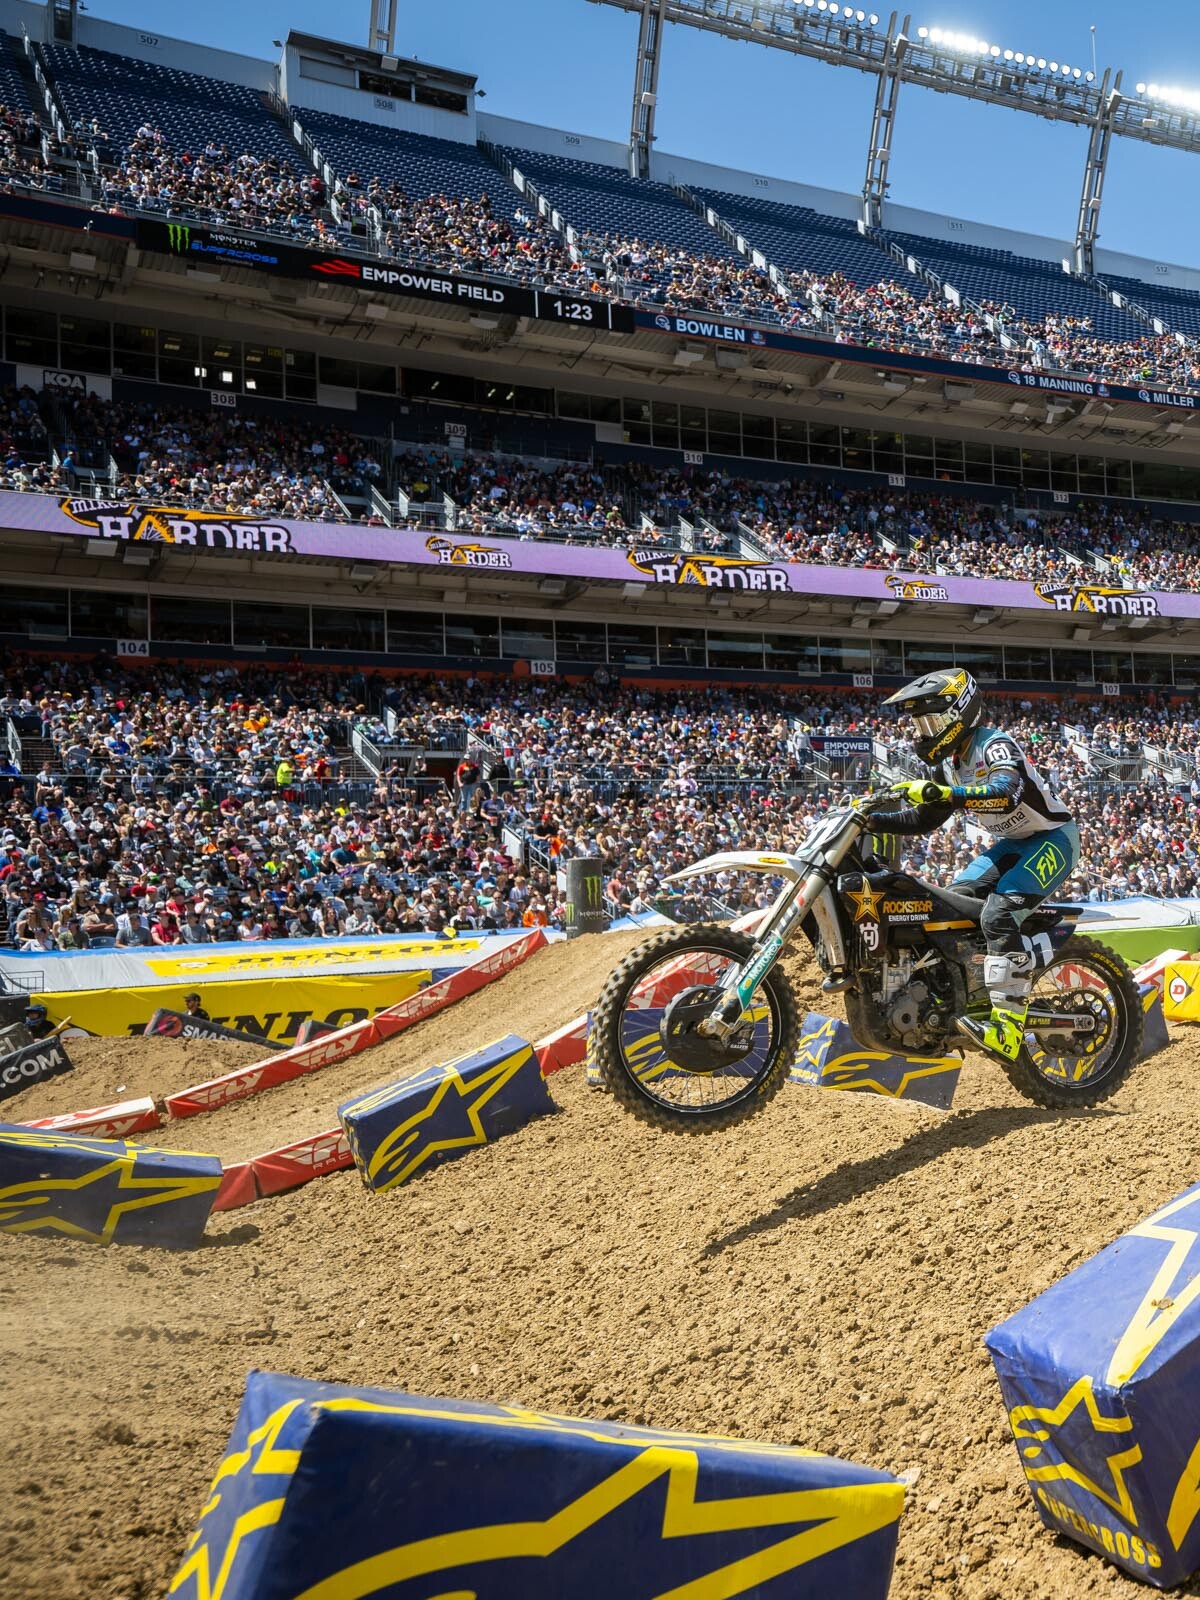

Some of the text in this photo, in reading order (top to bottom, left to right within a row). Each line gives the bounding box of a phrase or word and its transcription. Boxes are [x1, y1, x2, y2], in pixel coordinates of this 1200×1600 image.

[140, 35, 158, 46] 507
[376, 99, 393, 109] 508
[564, 136, 580, 145] 509
[210, 233, 257, 248] MONSTER
[362, 267, 593, 321] EMPOWER FIELD 1:23
[676, 318, 746, 342] BOWLEN
[44, 371, 84, 389] KOA
[1023, 374, 1093, 395] 18 MANNING
[212, 392, 235, 406] 308
[1153, 393, 1194, 408] MILLER
[446, 423, 466, 436] 309
[684, 452, 703, 463] 310
[889, 475, 905, 486] 311
[1054, 491, 1069, 502] 312
[96, 515, 291, 552] HARDER
[438, 549, 511, 567] HARDER
[652, 563, 791, 591] HARDER
[894, 585, 947, 601] HARDER
[1055, 594, 1158, 616] HARDER
[119, 641, 148, 654] 104
[533, 661, 554, 674] 105
[854, 675, 872, 687] 106
[1104, 684, 1119, 695] 107
[824, 742, 870, 751] EMPOWER
[927, 721, 965, 761] ROCKSTAR
[824, 748, 850, 758] FIELD
[964, 798, 1009, 808] ROCKSTAR
[986, 810, 1026, 833] sqvarna
[883, 900, 933, 914] ROCKSTAR
[888, 913, 930, 922] ENERGY DRINK
[751, 943, 783, 981] MOTOREX
[1092, 952, 1124, 978] DUNLOP
[1037, 1487, 1162, 1569] SUPERCROSS
